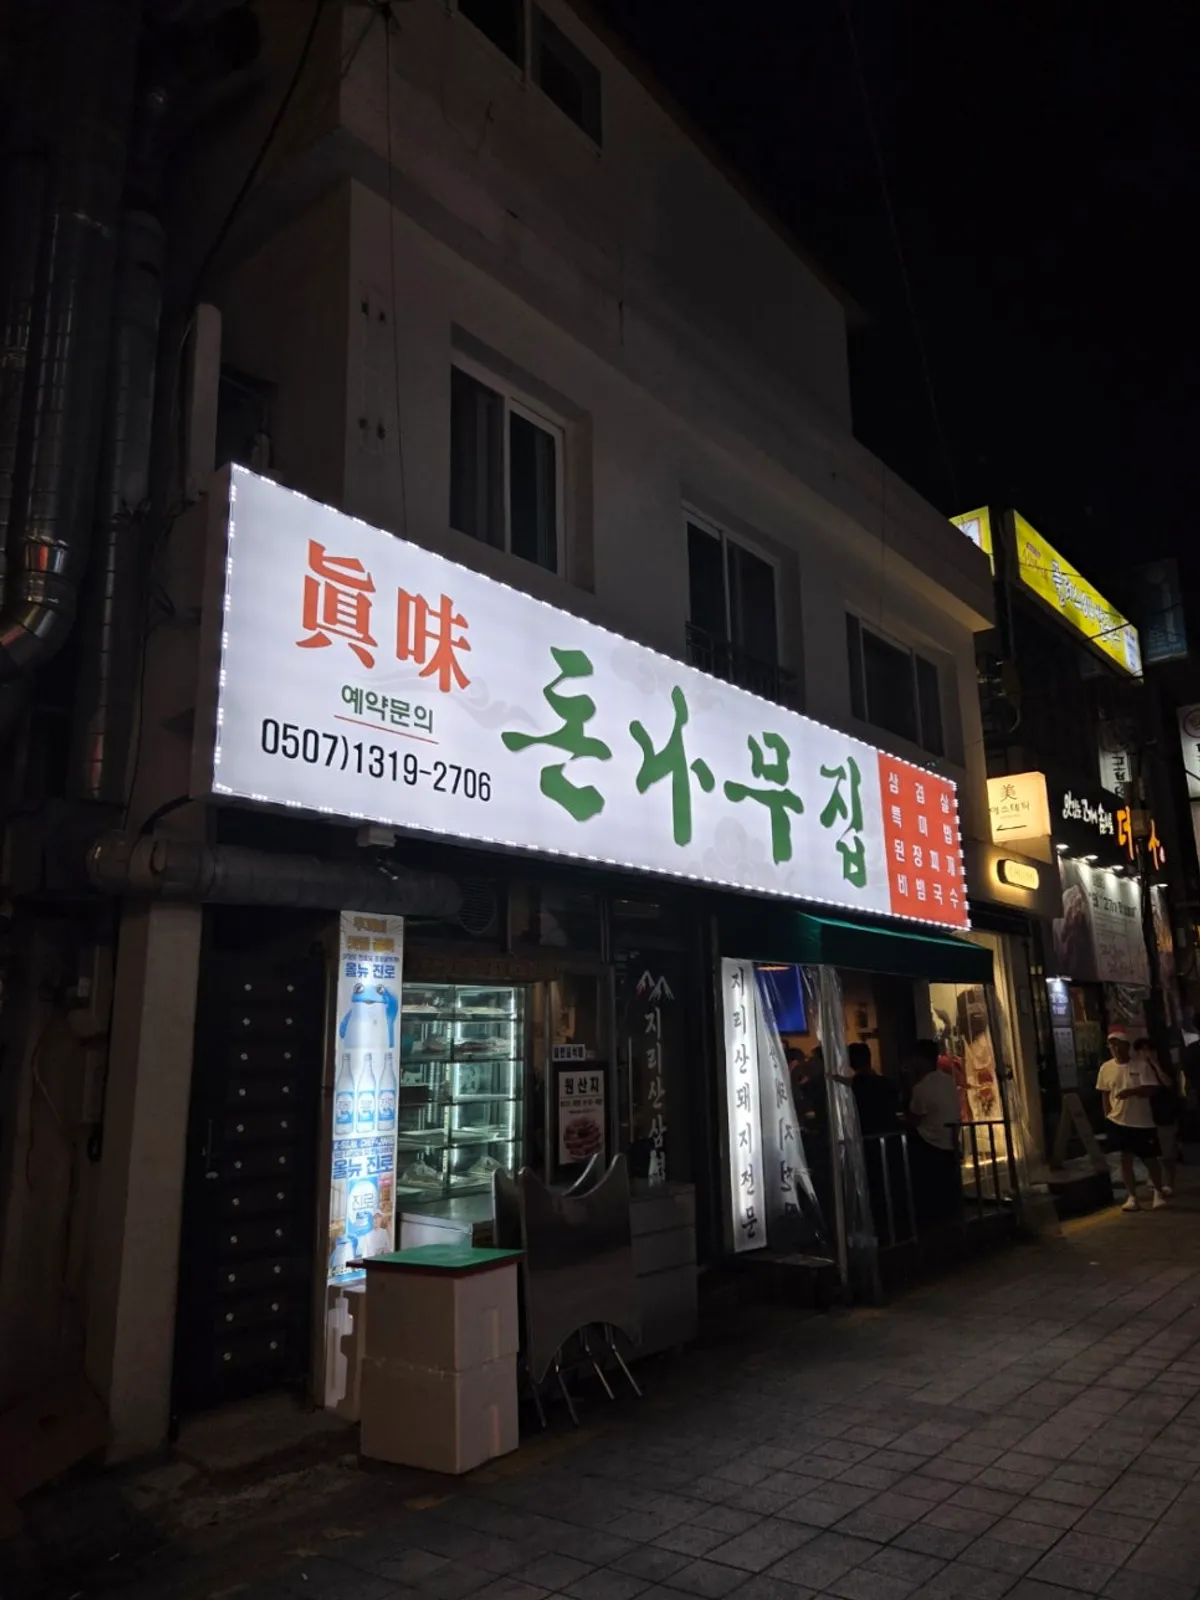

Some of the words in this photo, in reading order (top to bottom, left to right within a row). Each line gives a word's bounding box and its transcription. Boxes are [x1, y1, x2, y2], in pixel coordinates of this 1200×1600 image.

[296, 539, 471, 693] 眞味
[341, 684, 434, 733] 예약문의
[261, 718, 492, 803] 0507)1319-2706
[897, 873, 959, 909] 비빔국수
[345, 962, 369, 979] 올뉴
[373, 963, 396, 979] 진로
[565, 1076, 600, 1095] 원산지
[732, 967, 757, 1239] 지리산돼지전문
[333, 1159, 362, 1180] 올뉴
[367, 1154, 394, 1178] 진로
